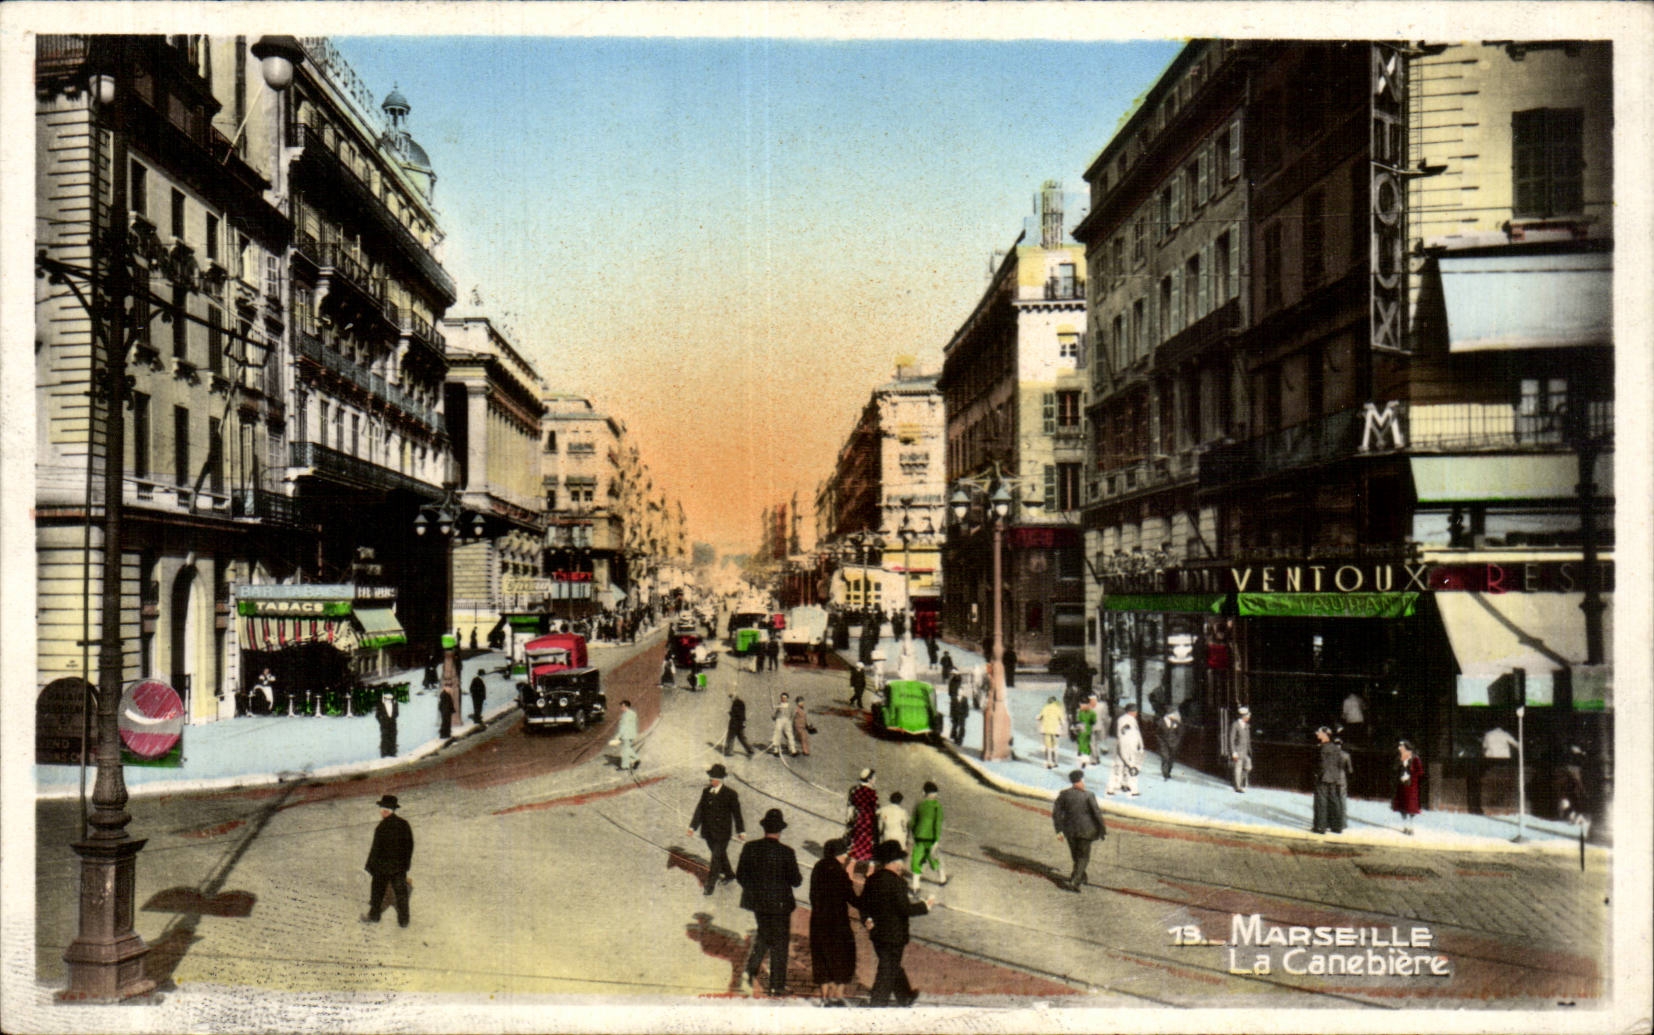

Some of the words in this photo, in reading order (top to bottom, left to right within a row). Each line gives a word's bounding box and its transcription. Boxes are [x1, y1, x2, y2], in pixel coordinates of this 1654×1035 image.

[1231, 564, 1427, 592] VENTOUX
[240, 585, 273, 597] BAR
[256, 601, 324, 612] TABACS
